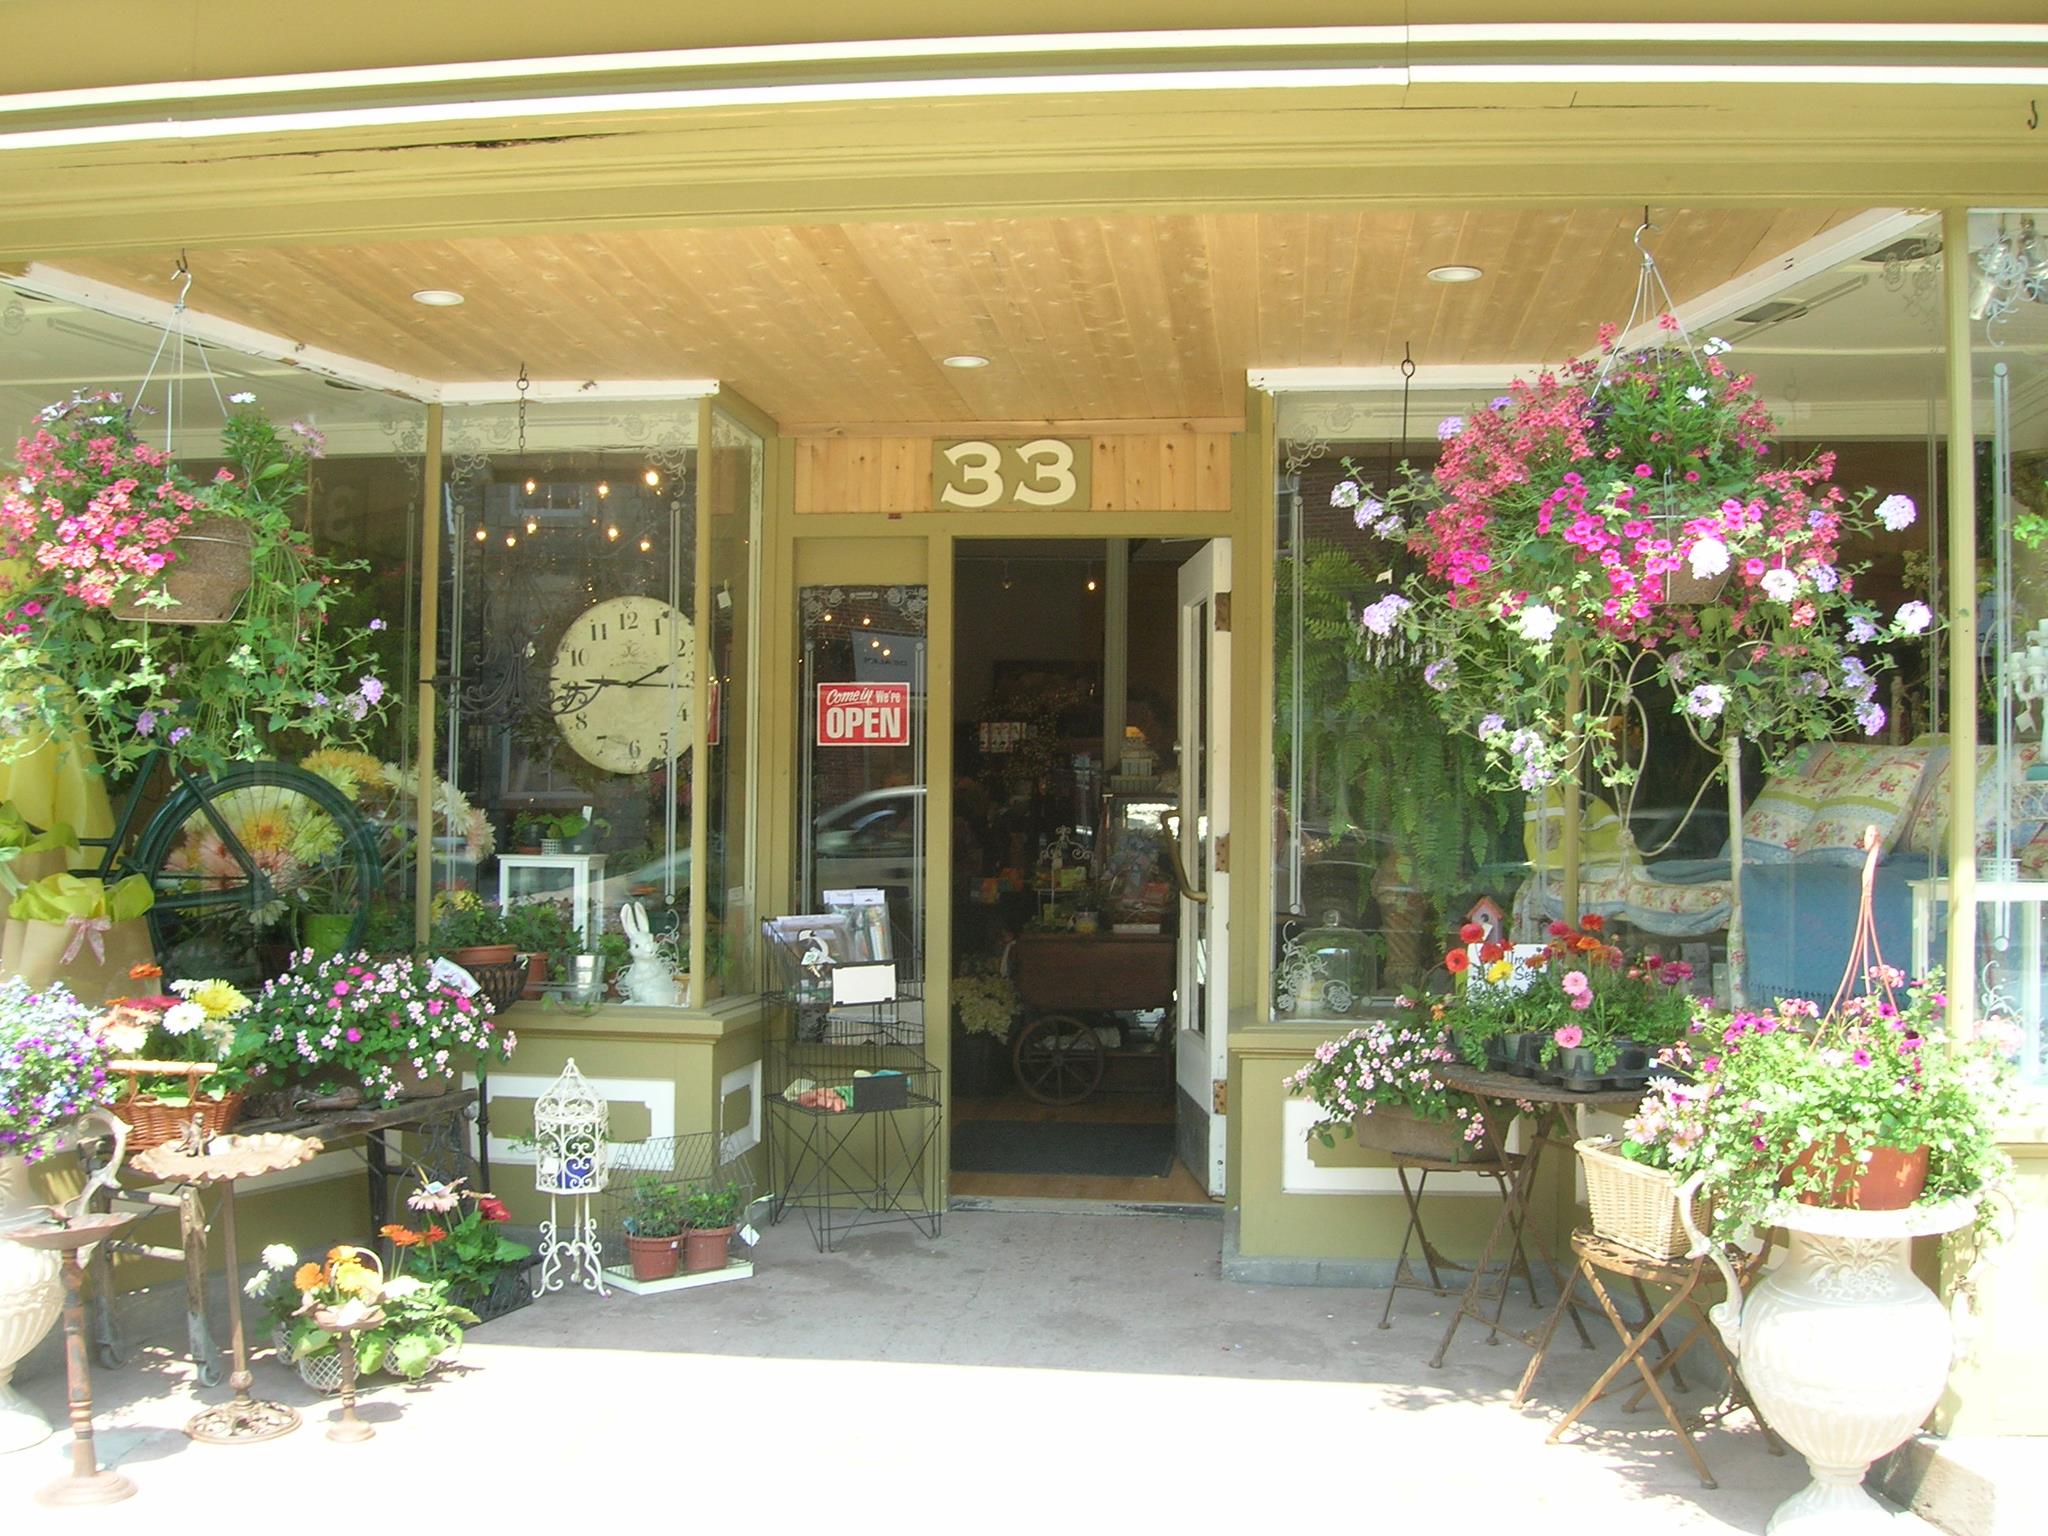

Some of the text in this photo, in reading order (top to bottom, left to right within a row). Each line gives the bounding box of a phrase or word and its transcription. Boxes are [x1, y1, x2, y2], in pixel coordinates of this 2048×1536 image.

[941, 439, 1077, 508] 33
[619, 611, 638, 630] 12
[655, 618, 661, 635] 1
[591, 624, 607, 641] 11
[677, 638, 686, 657] 2
[571, 648, 590, 667] 10
[826, 687, 901, 706] Come in We're
[575, 711, 588, 730] 8
[676, 702, 690, 721] 4
[826, 707, 901, 739] OPEN
[596, 736, 607, 756] 7
[629, 740, 641, 759] 6
